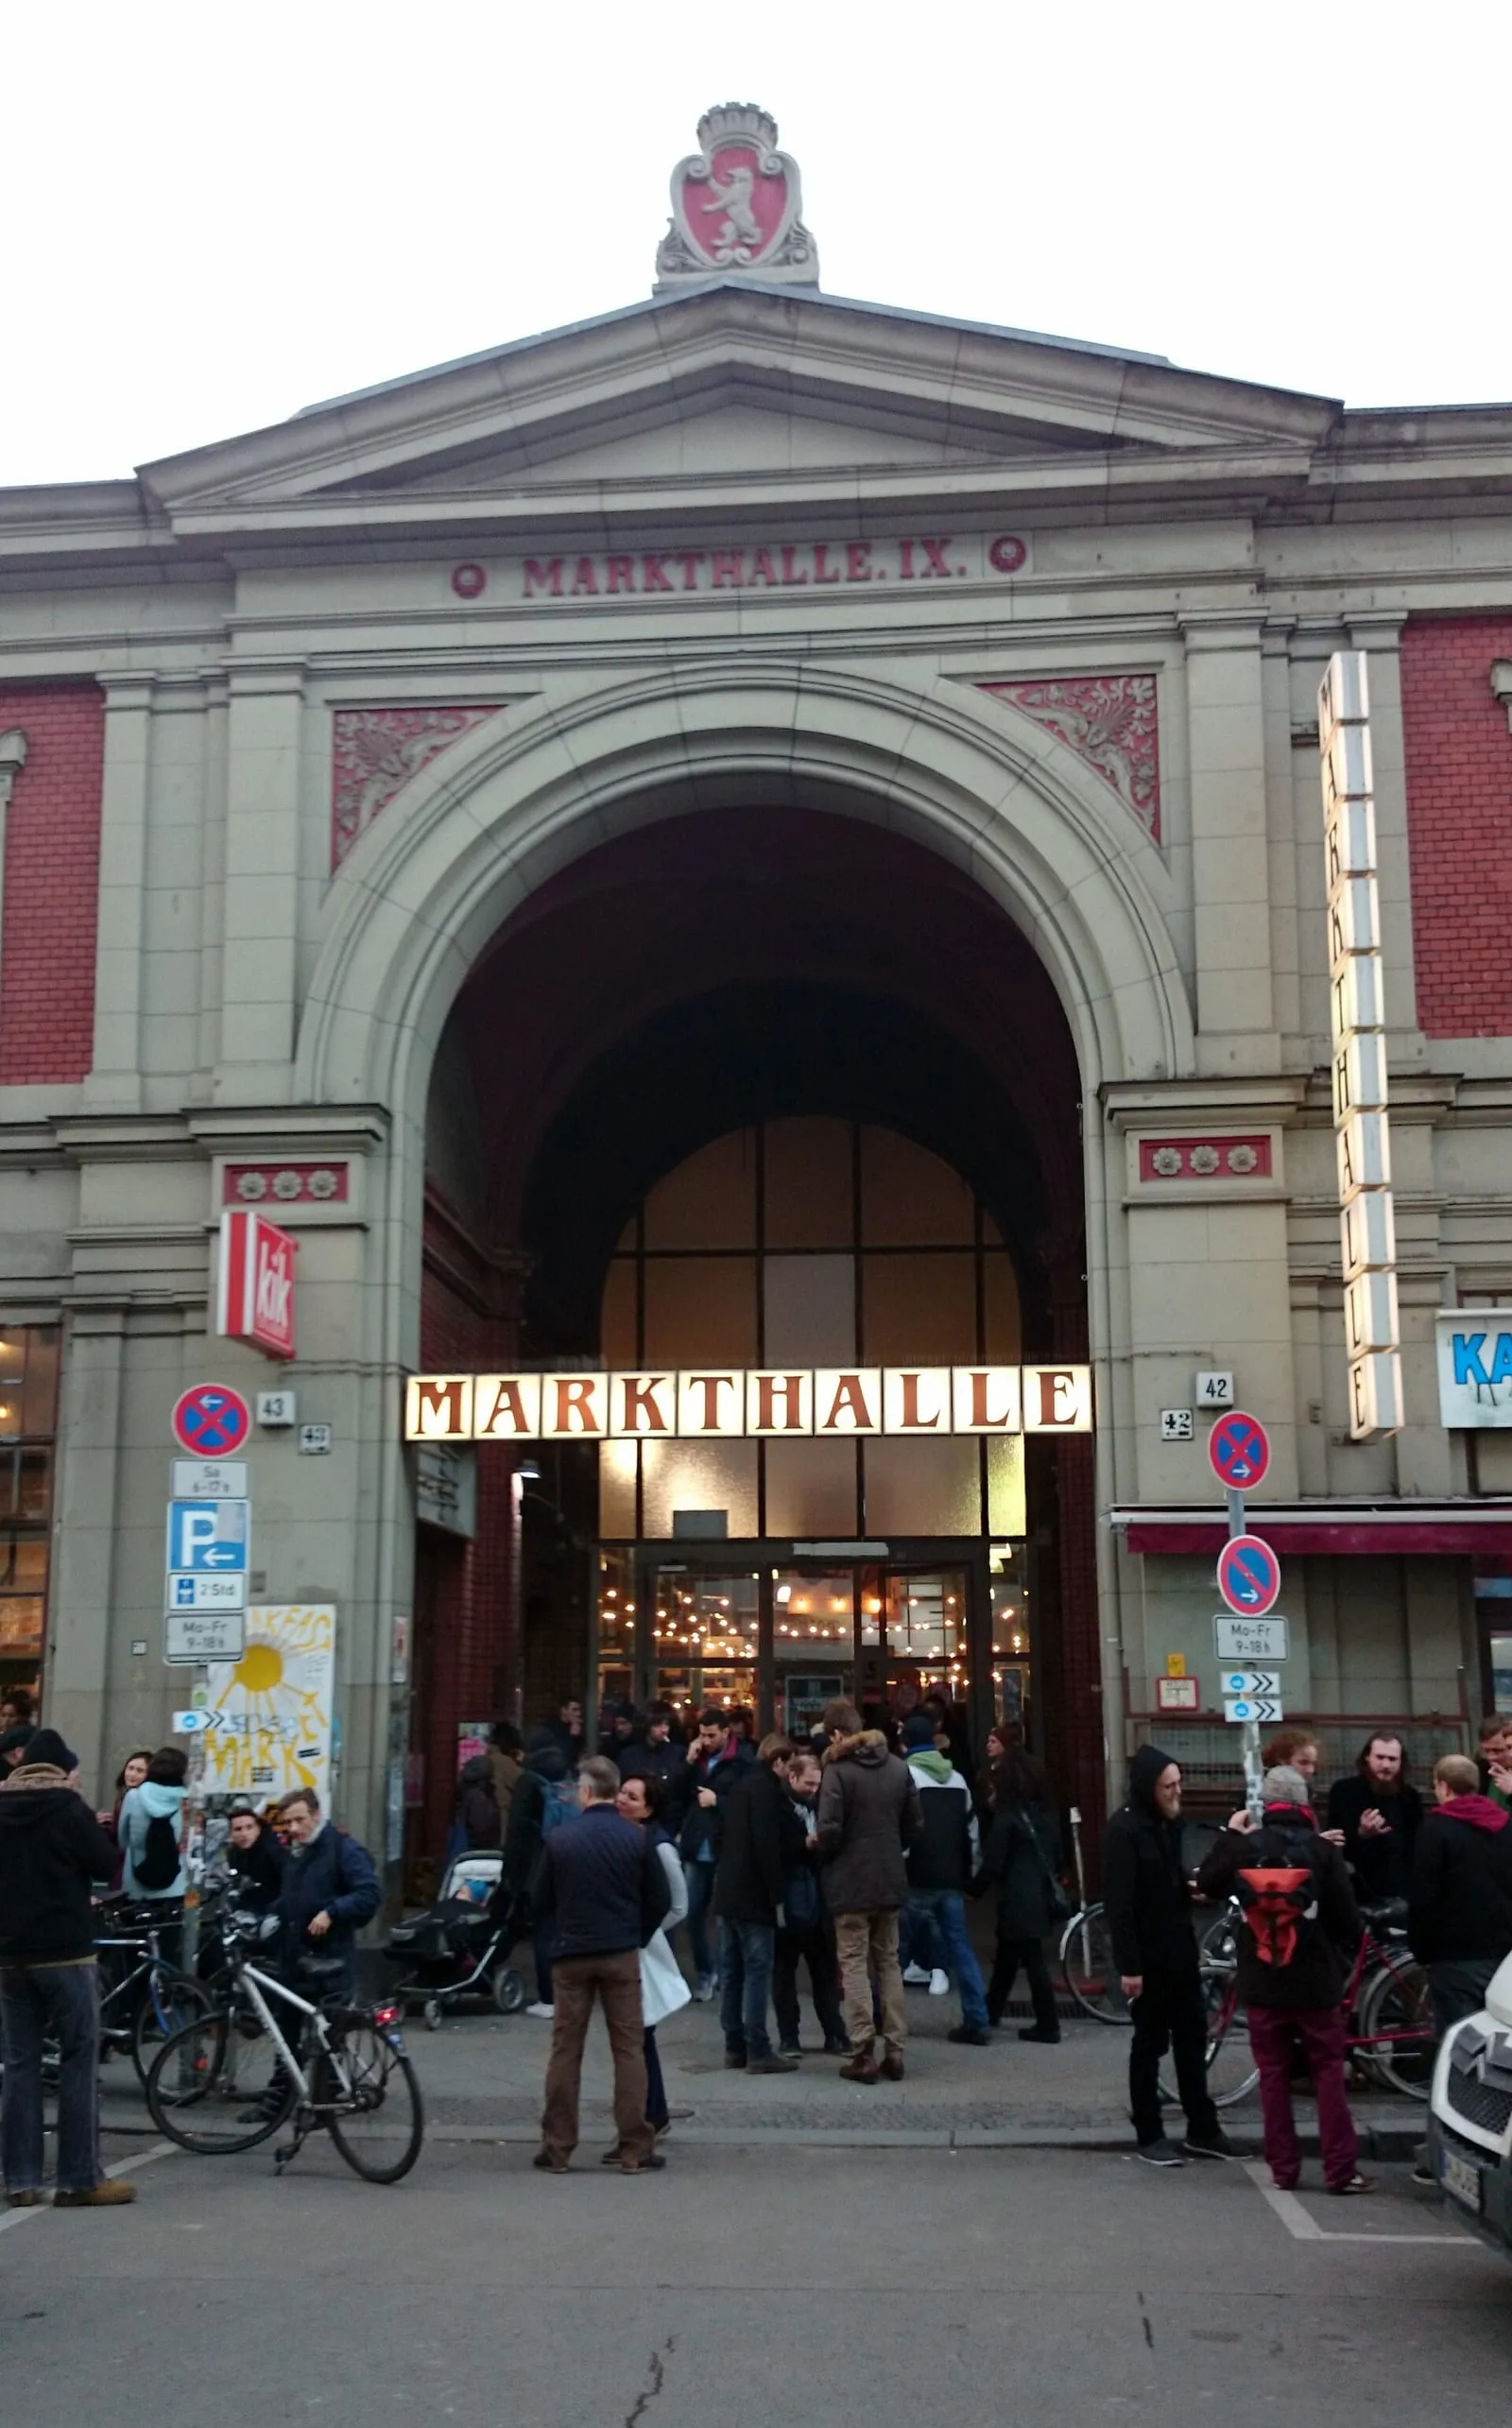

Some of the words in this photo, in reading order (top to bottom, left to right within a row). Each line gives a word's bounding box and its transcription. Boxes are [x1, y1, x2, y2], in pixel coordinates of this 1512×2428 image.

[1320, 662, 1366, 1431] MARKTHALLE
[1205, 1378, 1228, 1399] 42
[263, 1398, 284, 1418] 43
[416, 1369, 1079, 1435] MARKTHALLE
[1164, 1413, 1191, 1430] 42
[303, 1428, 326, 1443] 43
[180, 1510, 218, 1568] P
[182, 1620, 228, 1634] Mo-Fr
[1231, 1623, 1271, 1637] Mo-Fr
[1236, 1640, 1263, 1654] 9-18
